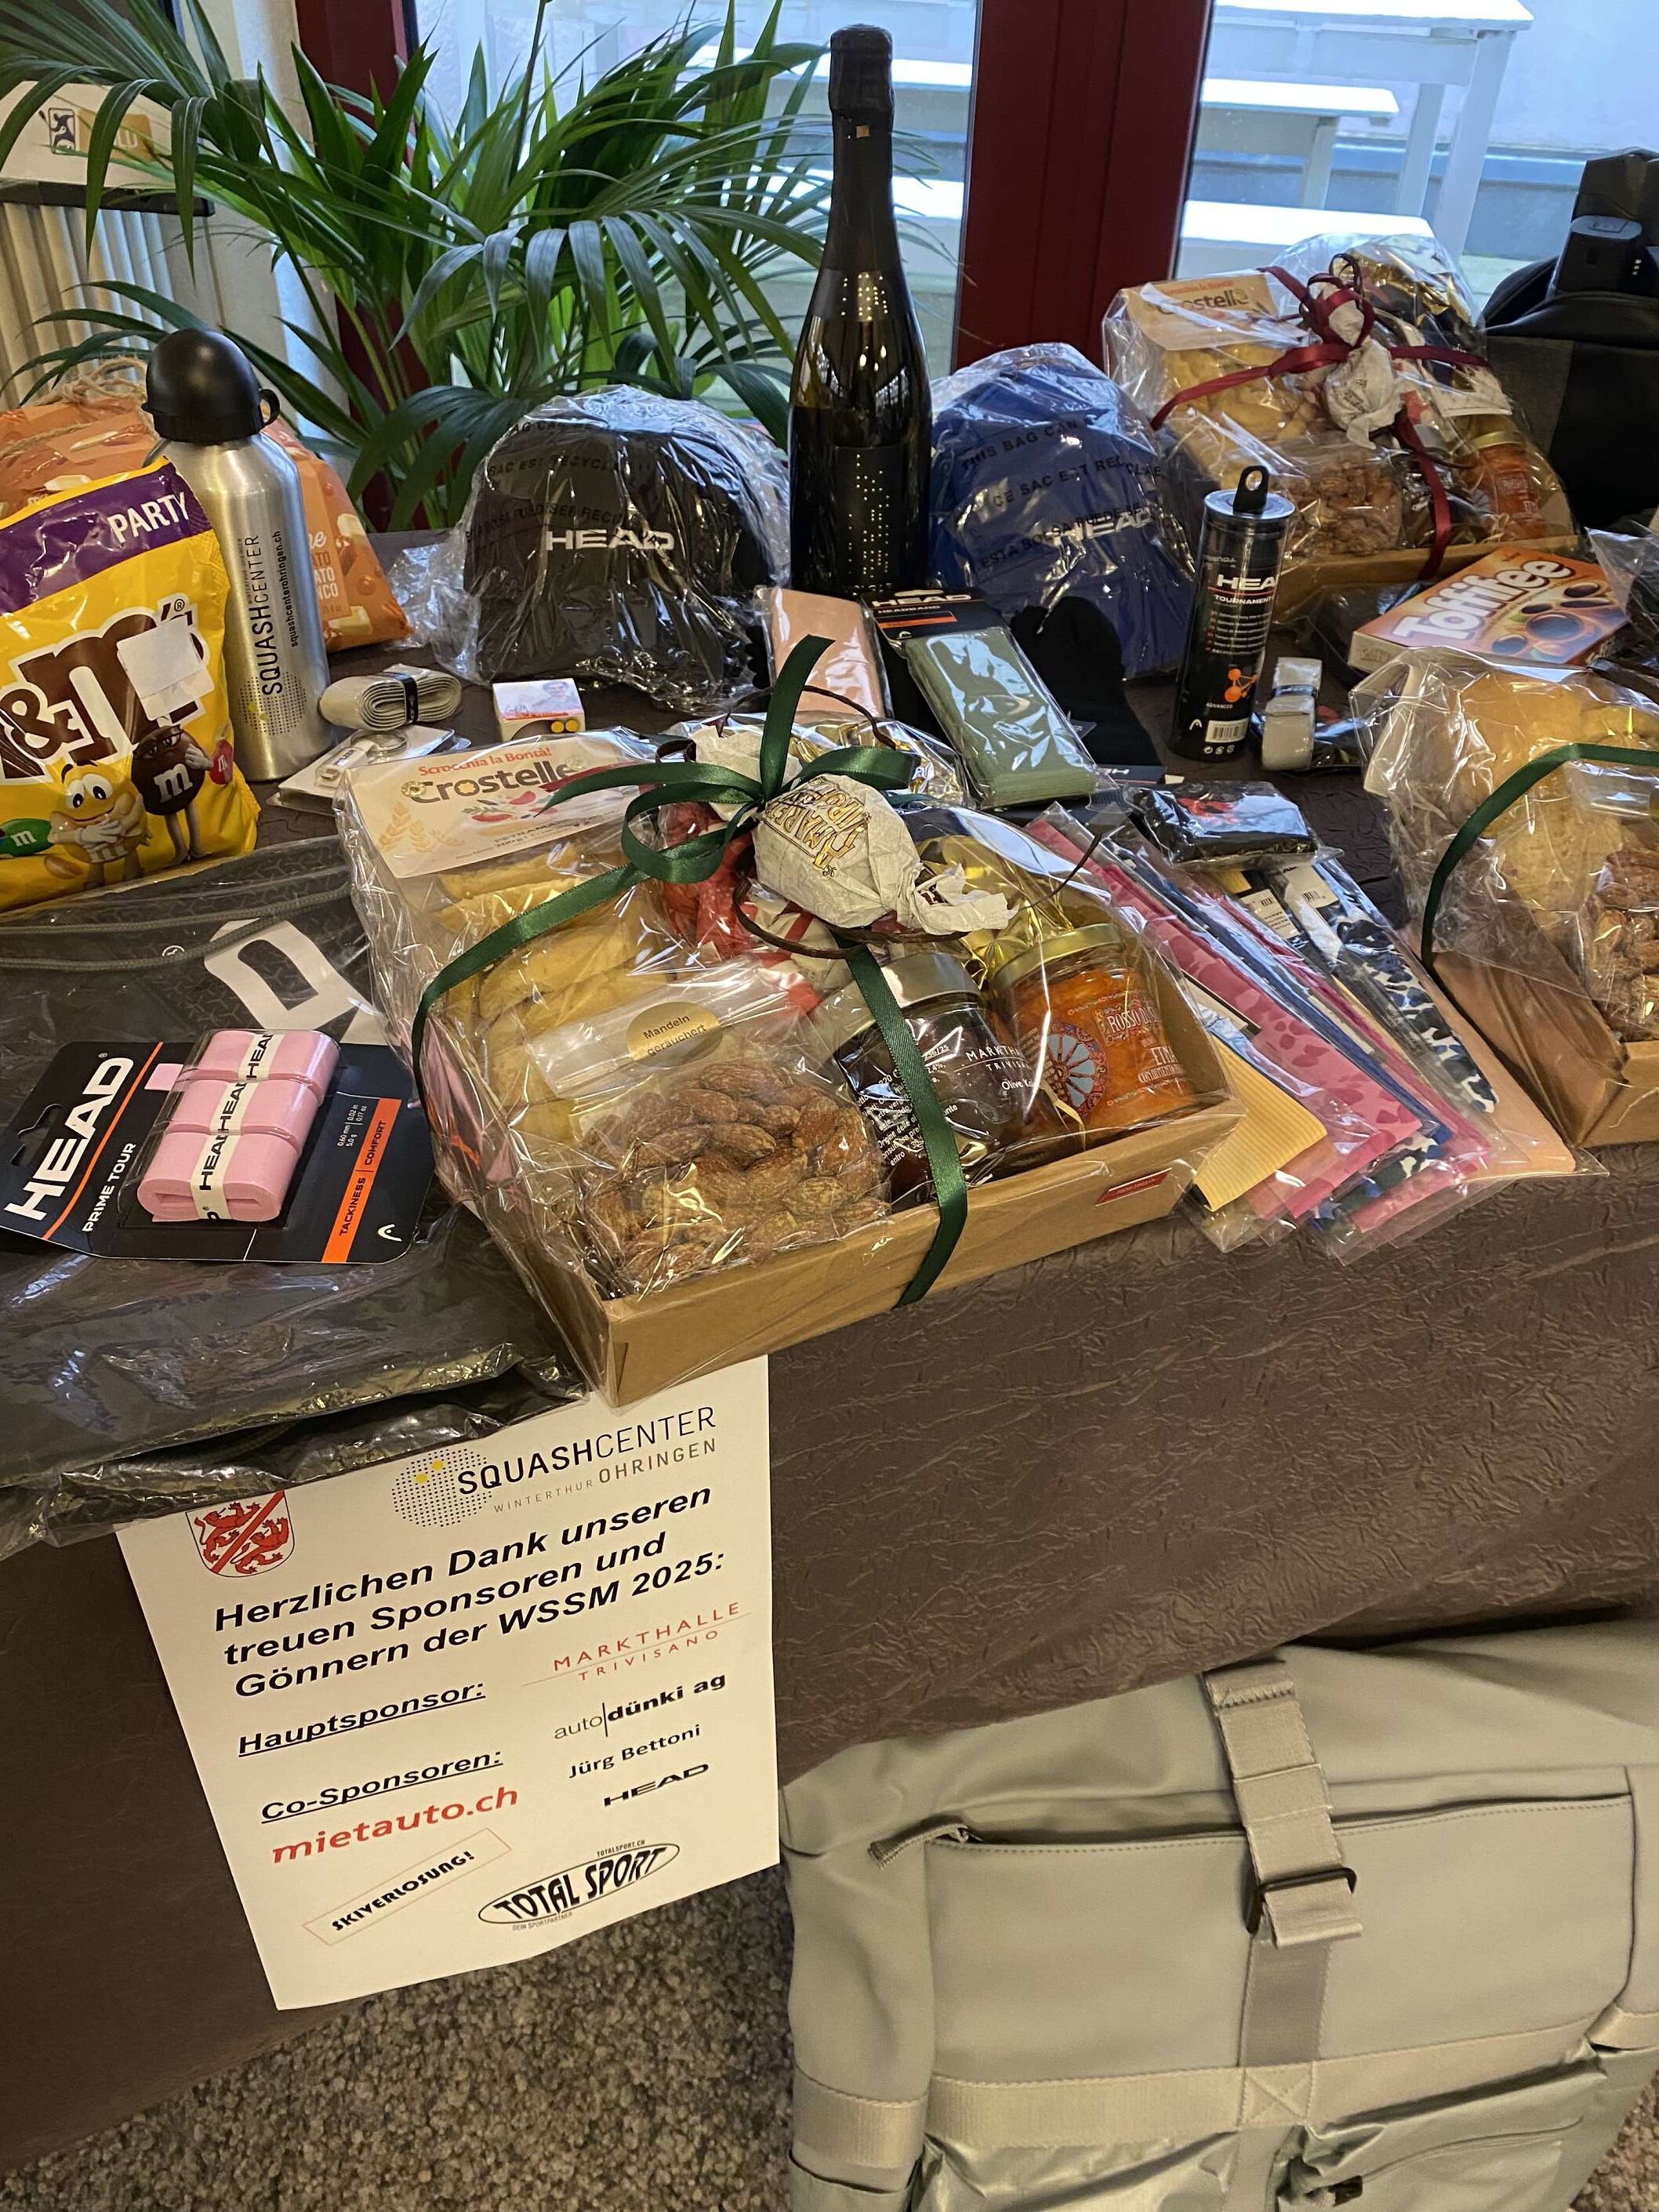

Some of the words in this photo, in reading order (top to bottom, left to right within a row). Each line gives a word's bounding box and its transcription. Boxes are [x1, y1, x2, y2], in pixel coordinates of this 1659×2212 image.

[519, 458, 545, 470] EST
[1003, 431, 1039, 452] BAG
[993, 489, 1016, 508] CE
[1021, 473, 1054, 496] SAC
[107, 491, 191, 543] PARTY
[546, 528, 675, 552] HEAD
[272, 531, 299, 647] squashcenterohringen.ch
[872, 594, 972, 607] HEAD
[1216, 575, 1277, 590] HEA
[1392, 559, 1577, 641] Toffifee
[245, 535, 283, 695] SQUASHCENTER
[153, 763, 194, 803] m
[491, 755, 504, 766] la
[10, 830, 37, 848] m
[642, 1016, 691, 1040] Mandeln
[1107, 1008, 1142, 1033] ROSSO
[246, 1034, 274, 1080] HEA
[218, 1082, 248, 1133] HEA
[1000, 1079, 1025, 1091] Olive
[4, 1057, 135, 1221] HEAD
[199, 1134, 229, 1191] HEA
[890, 1151, 906, 1166] entro
[82, 1184, 115, 1232] PRIME
[107, 1142, 137, 1184] TOUR
[339, 1177, 367, 1237] TACKINESS
[364, 1120, 387, 1166] COMFORT
[458, 1407, 716, 1496] SQUASHCENTER
[494, 1479, 593, 1514] WINTERTHUR
[599, 1438, 717, 1484] OHRINGEN
[216, 1565, 434, 1632] Herzlichen
[448, 1532, 549, 1576] Dank
[562, 1489, 711, 1546] unseren
[224, 1621, 355, 1665] treuen
[370, 1562, 582, 1630] Sponsoren
[596, 1531, 666, 1572] und
[235, 1644, 409, 1698] Gönnern
[423, 1623, 488, 1652] der
[499, 1580, 620, 1635] WSSM
[631, 1553, 724, 1596] 2025:
[554, 1601, 740, 1671] MARKTHALLE
[578, 1630, 719, 1681] TRIVISANO
[693, 1674, 727, 1695] ag
[238, 1683, 485, 1756] Hauptsponsor:
[568, 1756, 615, 1779] Jürg
[621, 1724, 701, 1761] Bettoni
[261, 1751, 503, 1821] Co-Sponsoren:
[604, 1764, 710, 1807] HEAD
[272, 1786, 518, 1864] mietauto.ch
[597, 1839, 646, 1858] TOTALSPORT.CH
[331, 1851, 475, 1932] SKIVERLOSUNG!
[493, 1874, 581, 1920] TOTAL
[583, 1846, 669, 1900] SPORT
